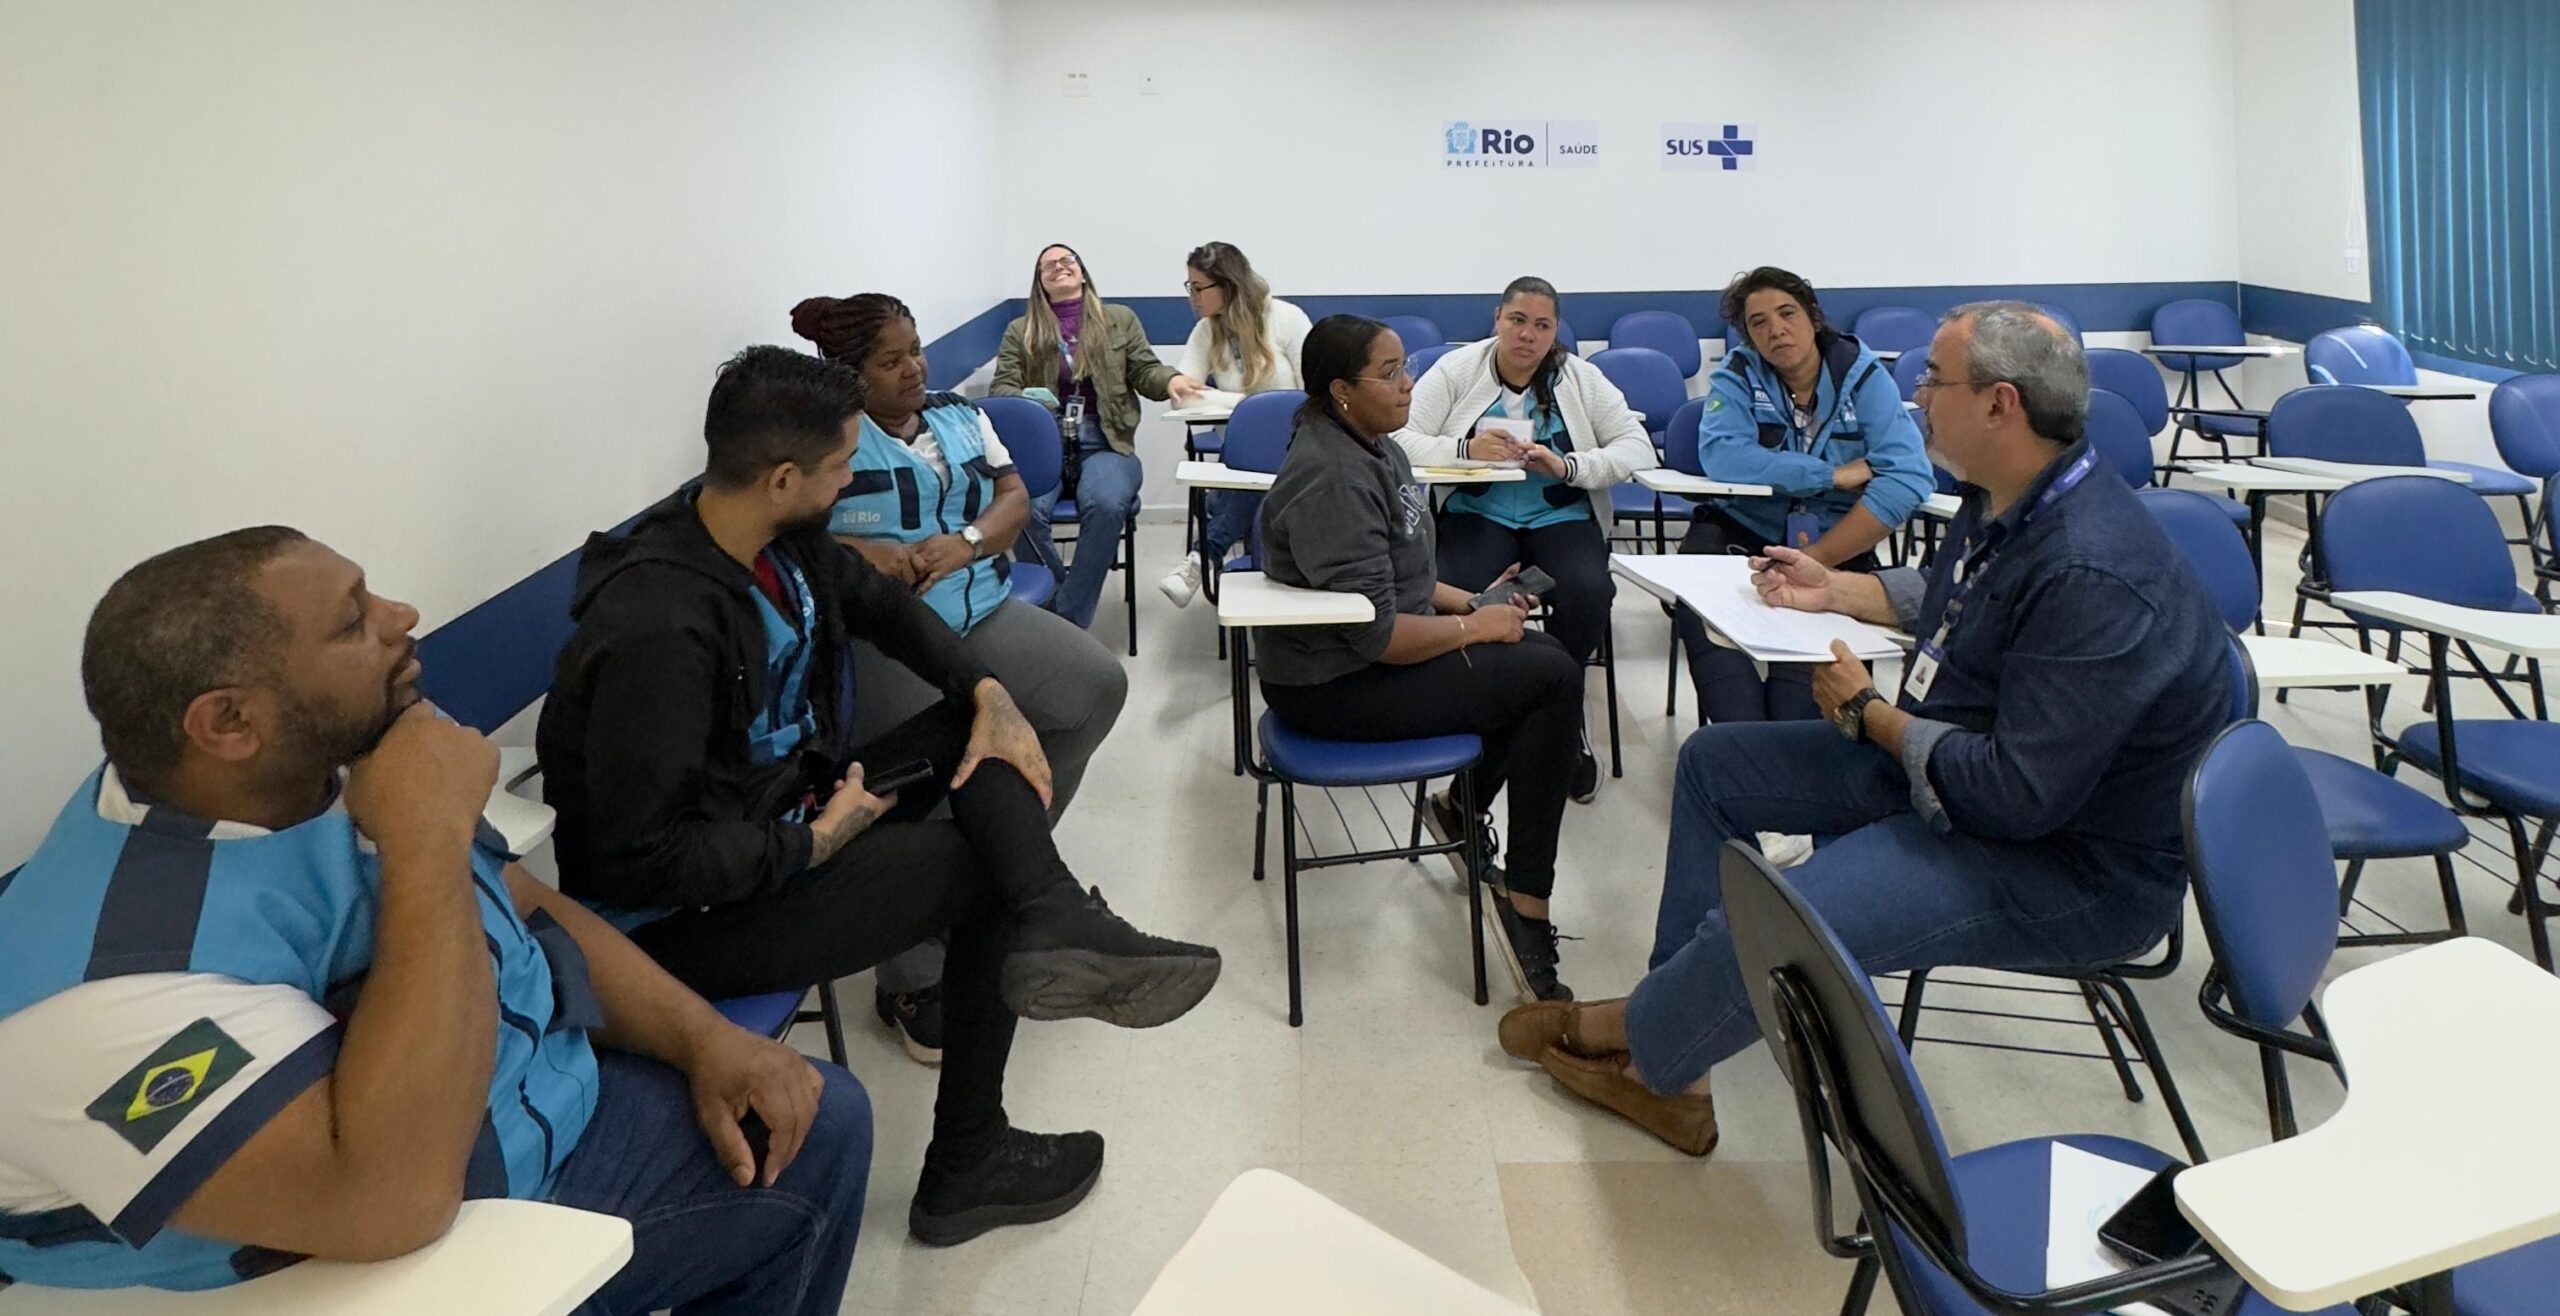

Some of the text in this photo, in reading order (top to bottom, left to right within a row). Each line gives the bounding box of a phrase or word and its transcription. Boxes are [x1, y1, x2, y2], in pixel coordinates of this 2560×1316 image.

[1482, 128, 1534, 154] Rio
[1559, 141, 1598, 154] SAÚDE
[1666, 139, 1703, 156] SUS
[1446, 160, 1534, 168] PREFEITURA
[857, 511, 881, 523] Rio
